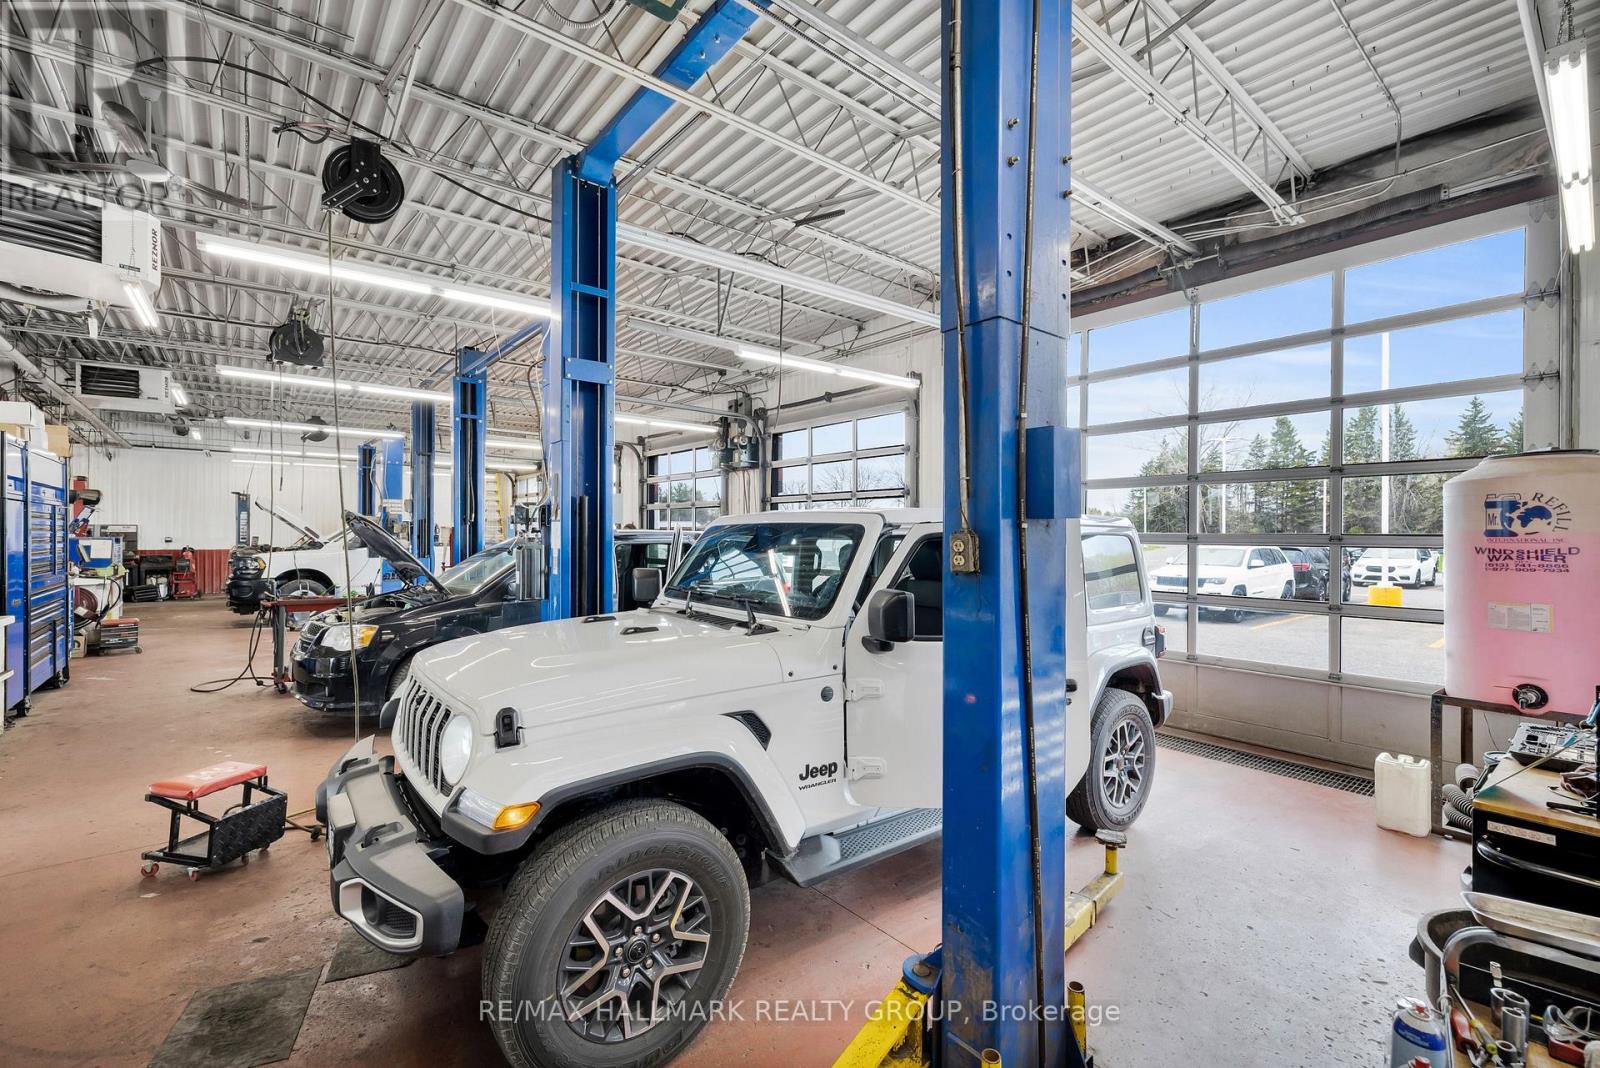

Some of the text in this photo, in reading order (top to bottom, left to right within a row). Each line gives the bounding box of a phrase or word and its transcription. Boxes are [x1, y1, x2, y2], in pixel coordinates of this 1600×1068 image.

[1532, 492, 1572, 532] REFILL
[1487, 512, 1500, 526] Mr.
[1474, 546, 1581, 556] WINDSHIELD
[1487, 554, 1567, 563] WASHER
[799, 762, 838, 781] Jeep
[798, 778, 837, 791] WRANGLER
